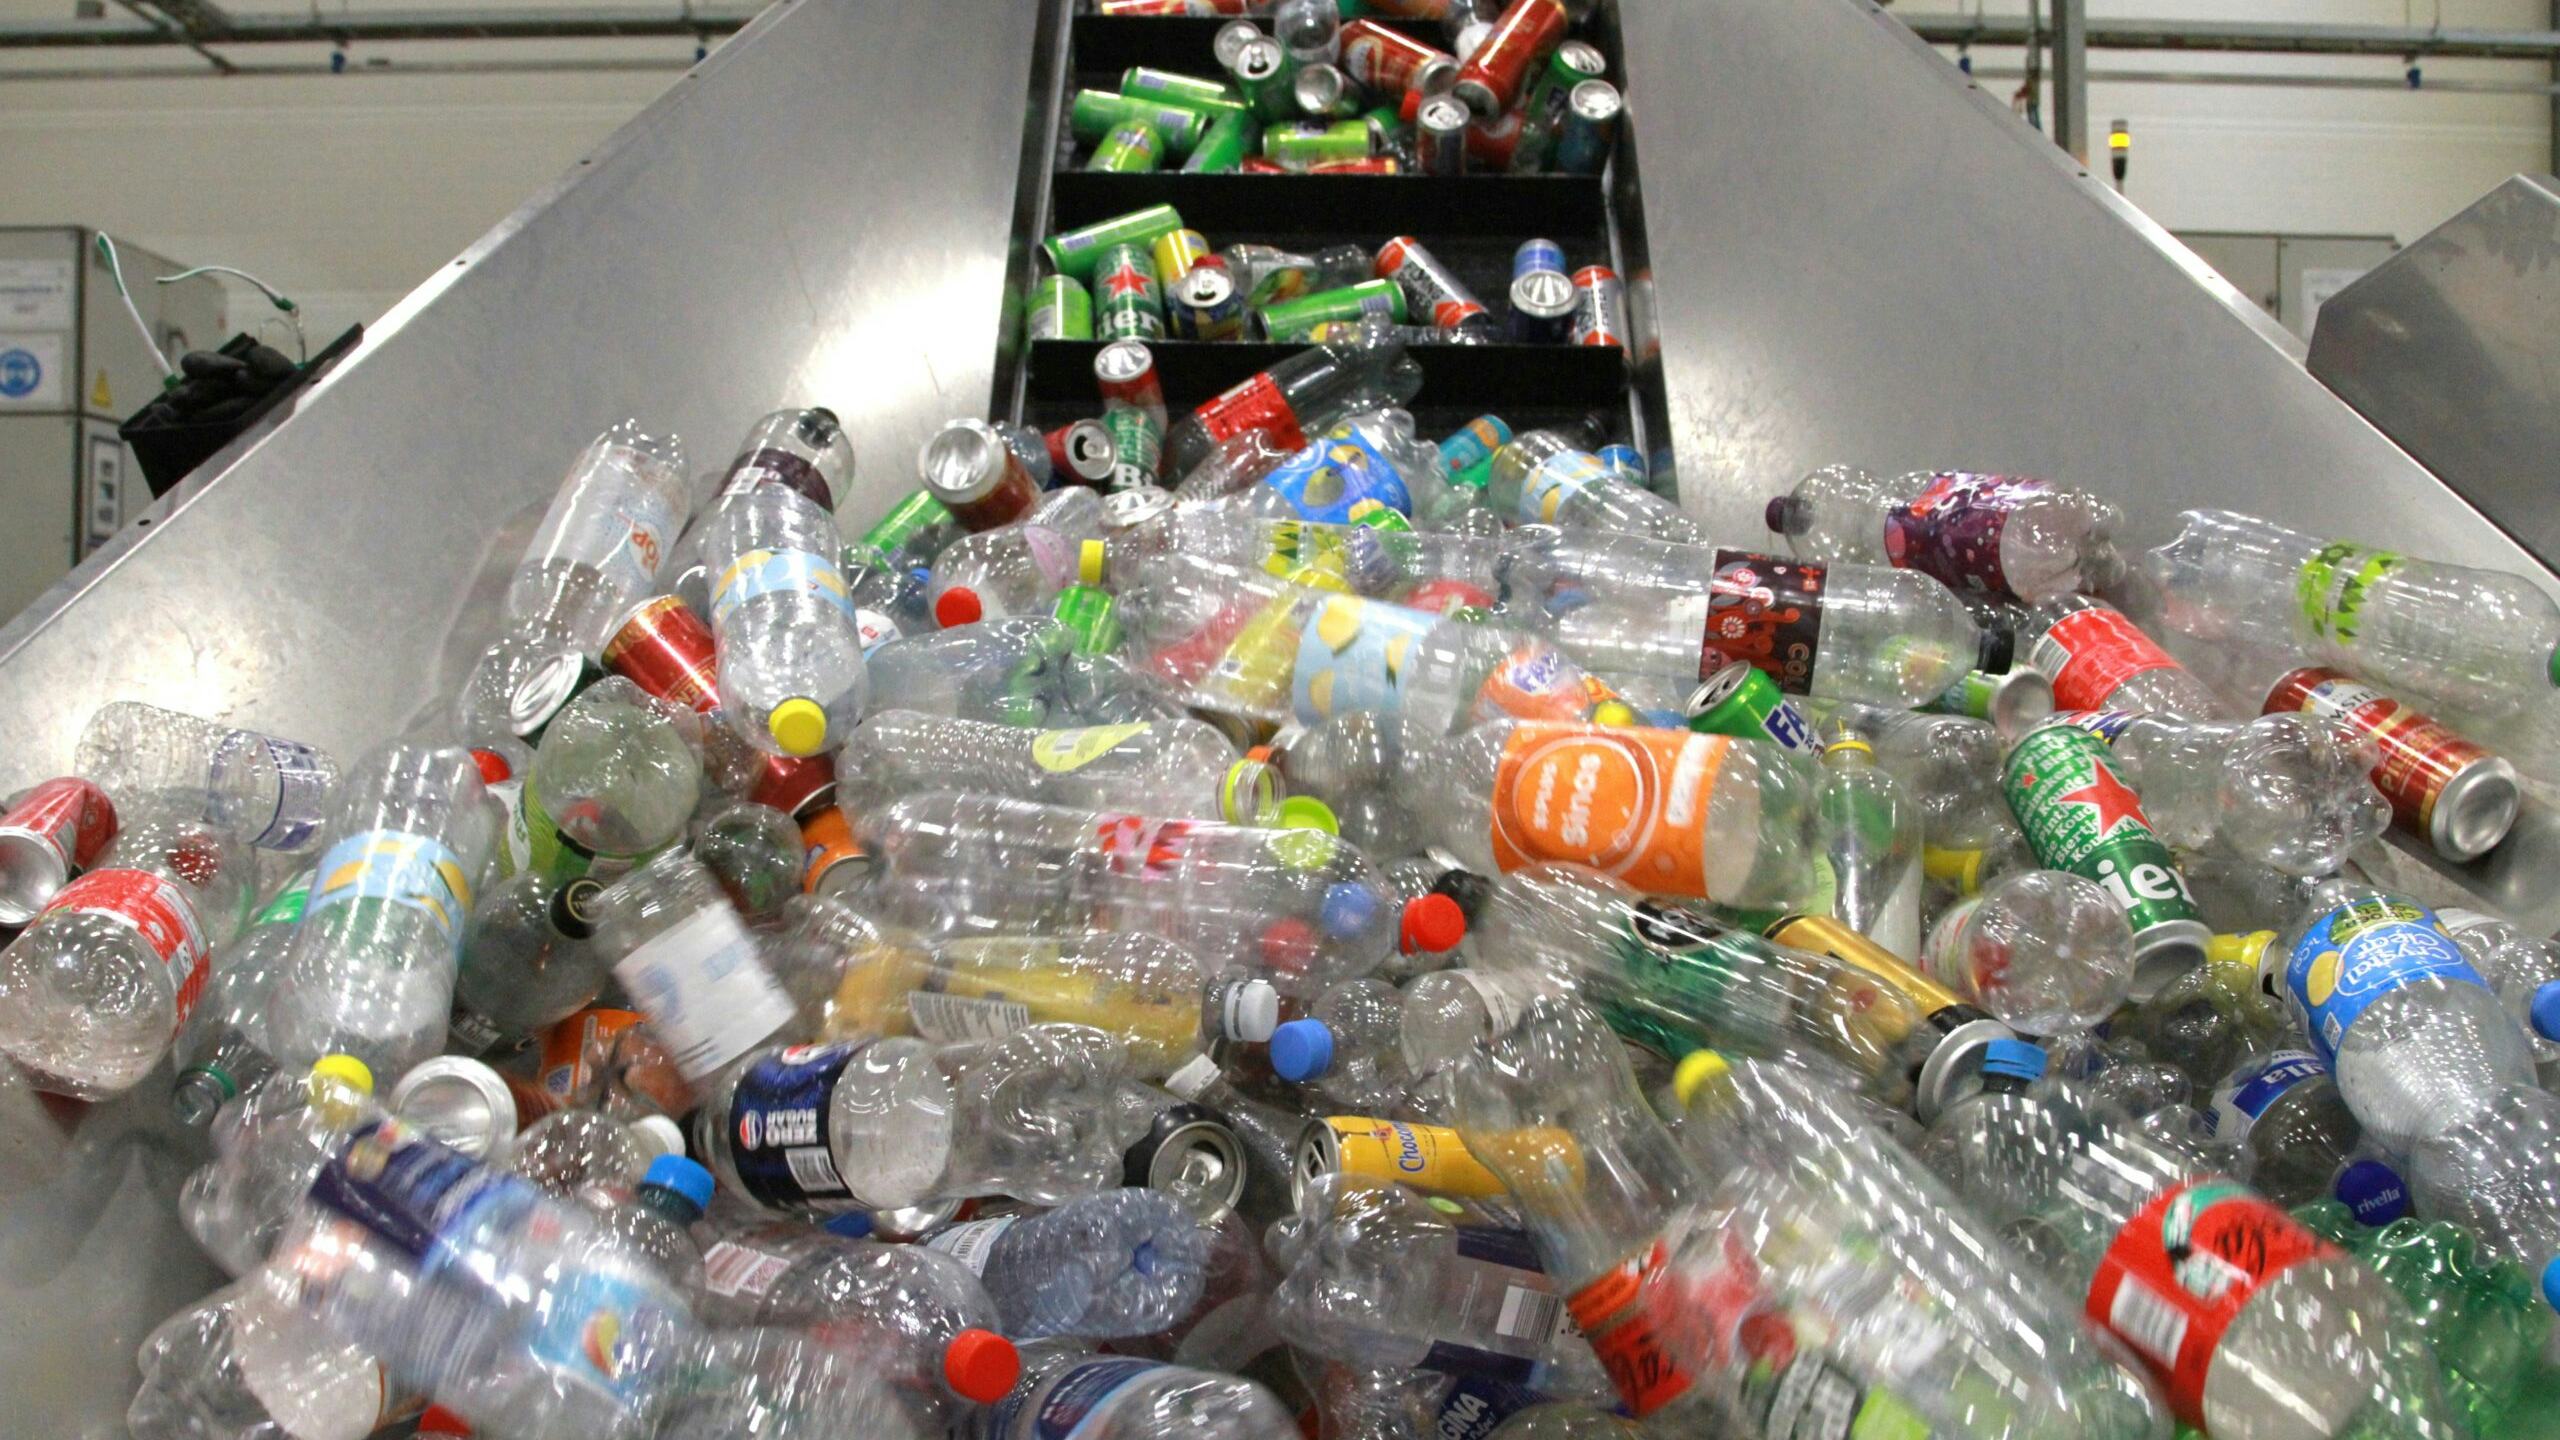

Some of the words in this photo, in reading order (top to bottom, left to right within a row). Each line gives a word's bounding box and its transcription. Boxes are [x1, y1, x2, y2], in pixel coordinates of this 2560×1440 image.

[2354, 930, 2439, 961] Clear
[2344, 940, 2452, 986] Crystal
[765, 1123, 818, 1148] ZERO
[2357, 1188, 2401, 1214] rivella
[1438, 1392, 1490, 1440] GINA
